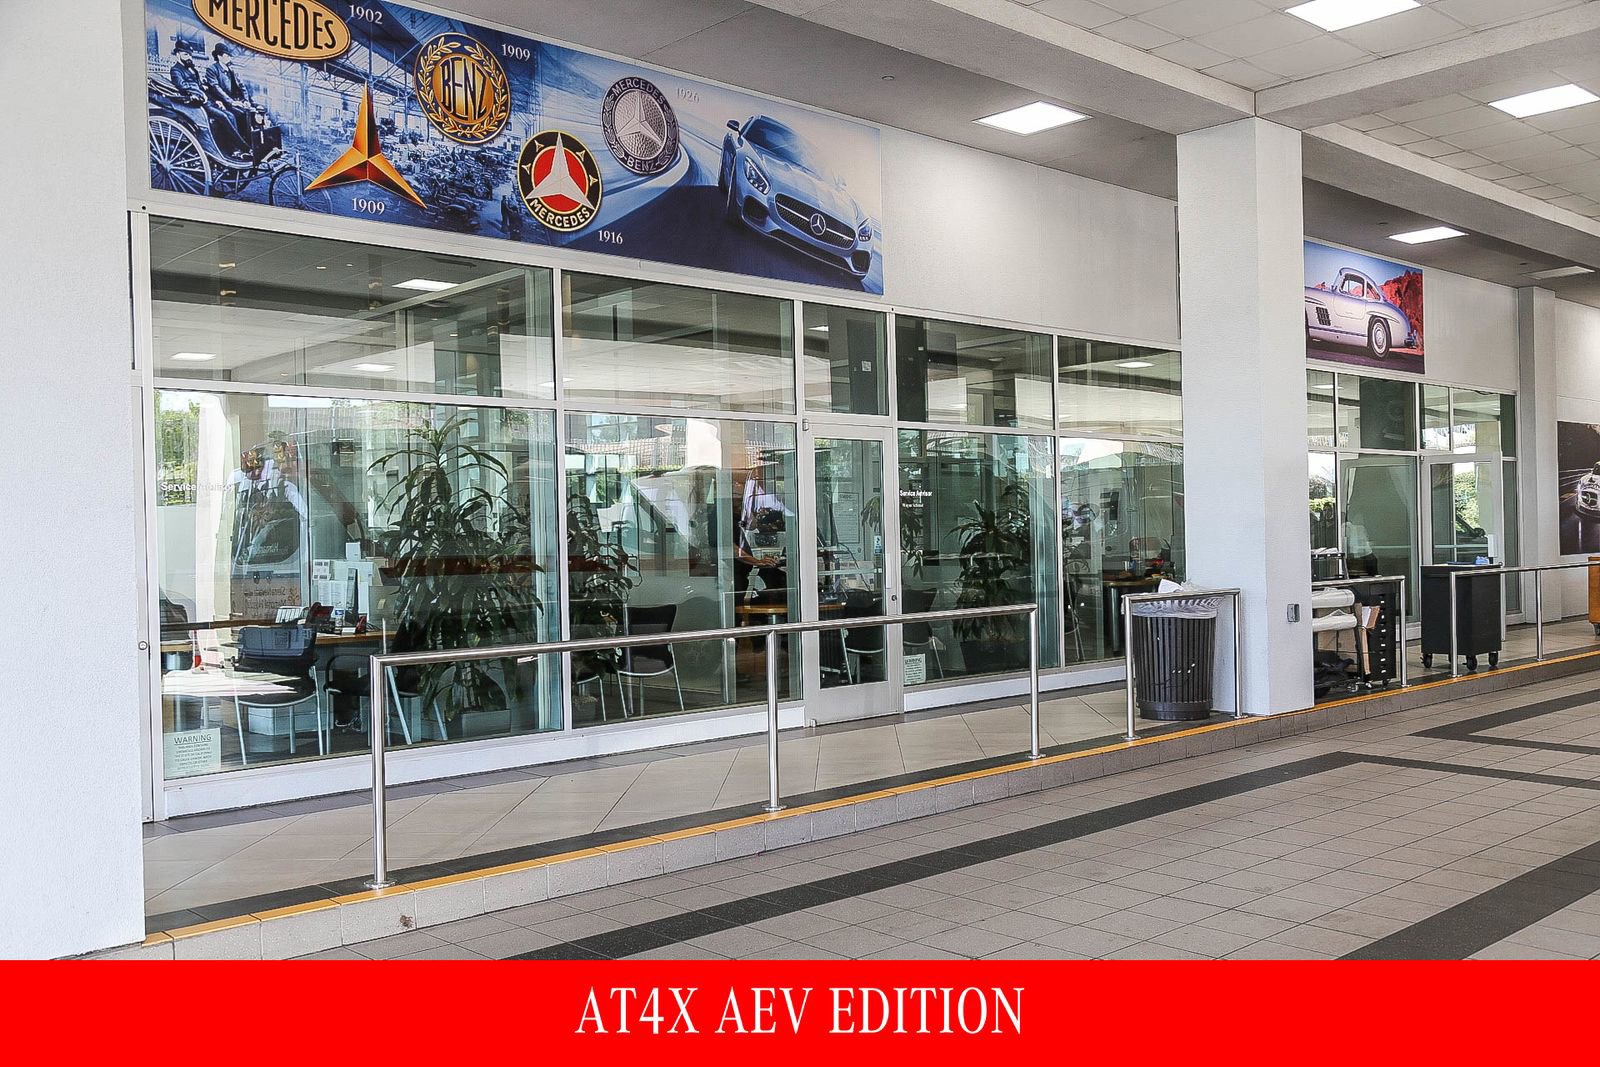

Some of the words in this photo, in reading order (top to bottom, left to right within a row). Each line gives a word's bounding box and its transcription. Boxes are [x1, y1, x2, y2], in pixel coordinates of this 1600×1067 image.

[349, 4, 384, 25] 1902
[209, 0, 337, 50] MERCEDES
[501, 43, 531, 61] 1909
[440, 56, 487, 121] BENZ
[611, 78, 666, 105] MERCEDES
[676, 87, 700, 103] 1926
[626, 157, 657, 171] BENZ
[352, 197, 385, 215] 1909
[529, 198, 590, 228] MERCEDES
[598, 229, 624, 245] 1916
[160, 481, 197, 491] Service
[173, 733, 213, 744] WARNING
